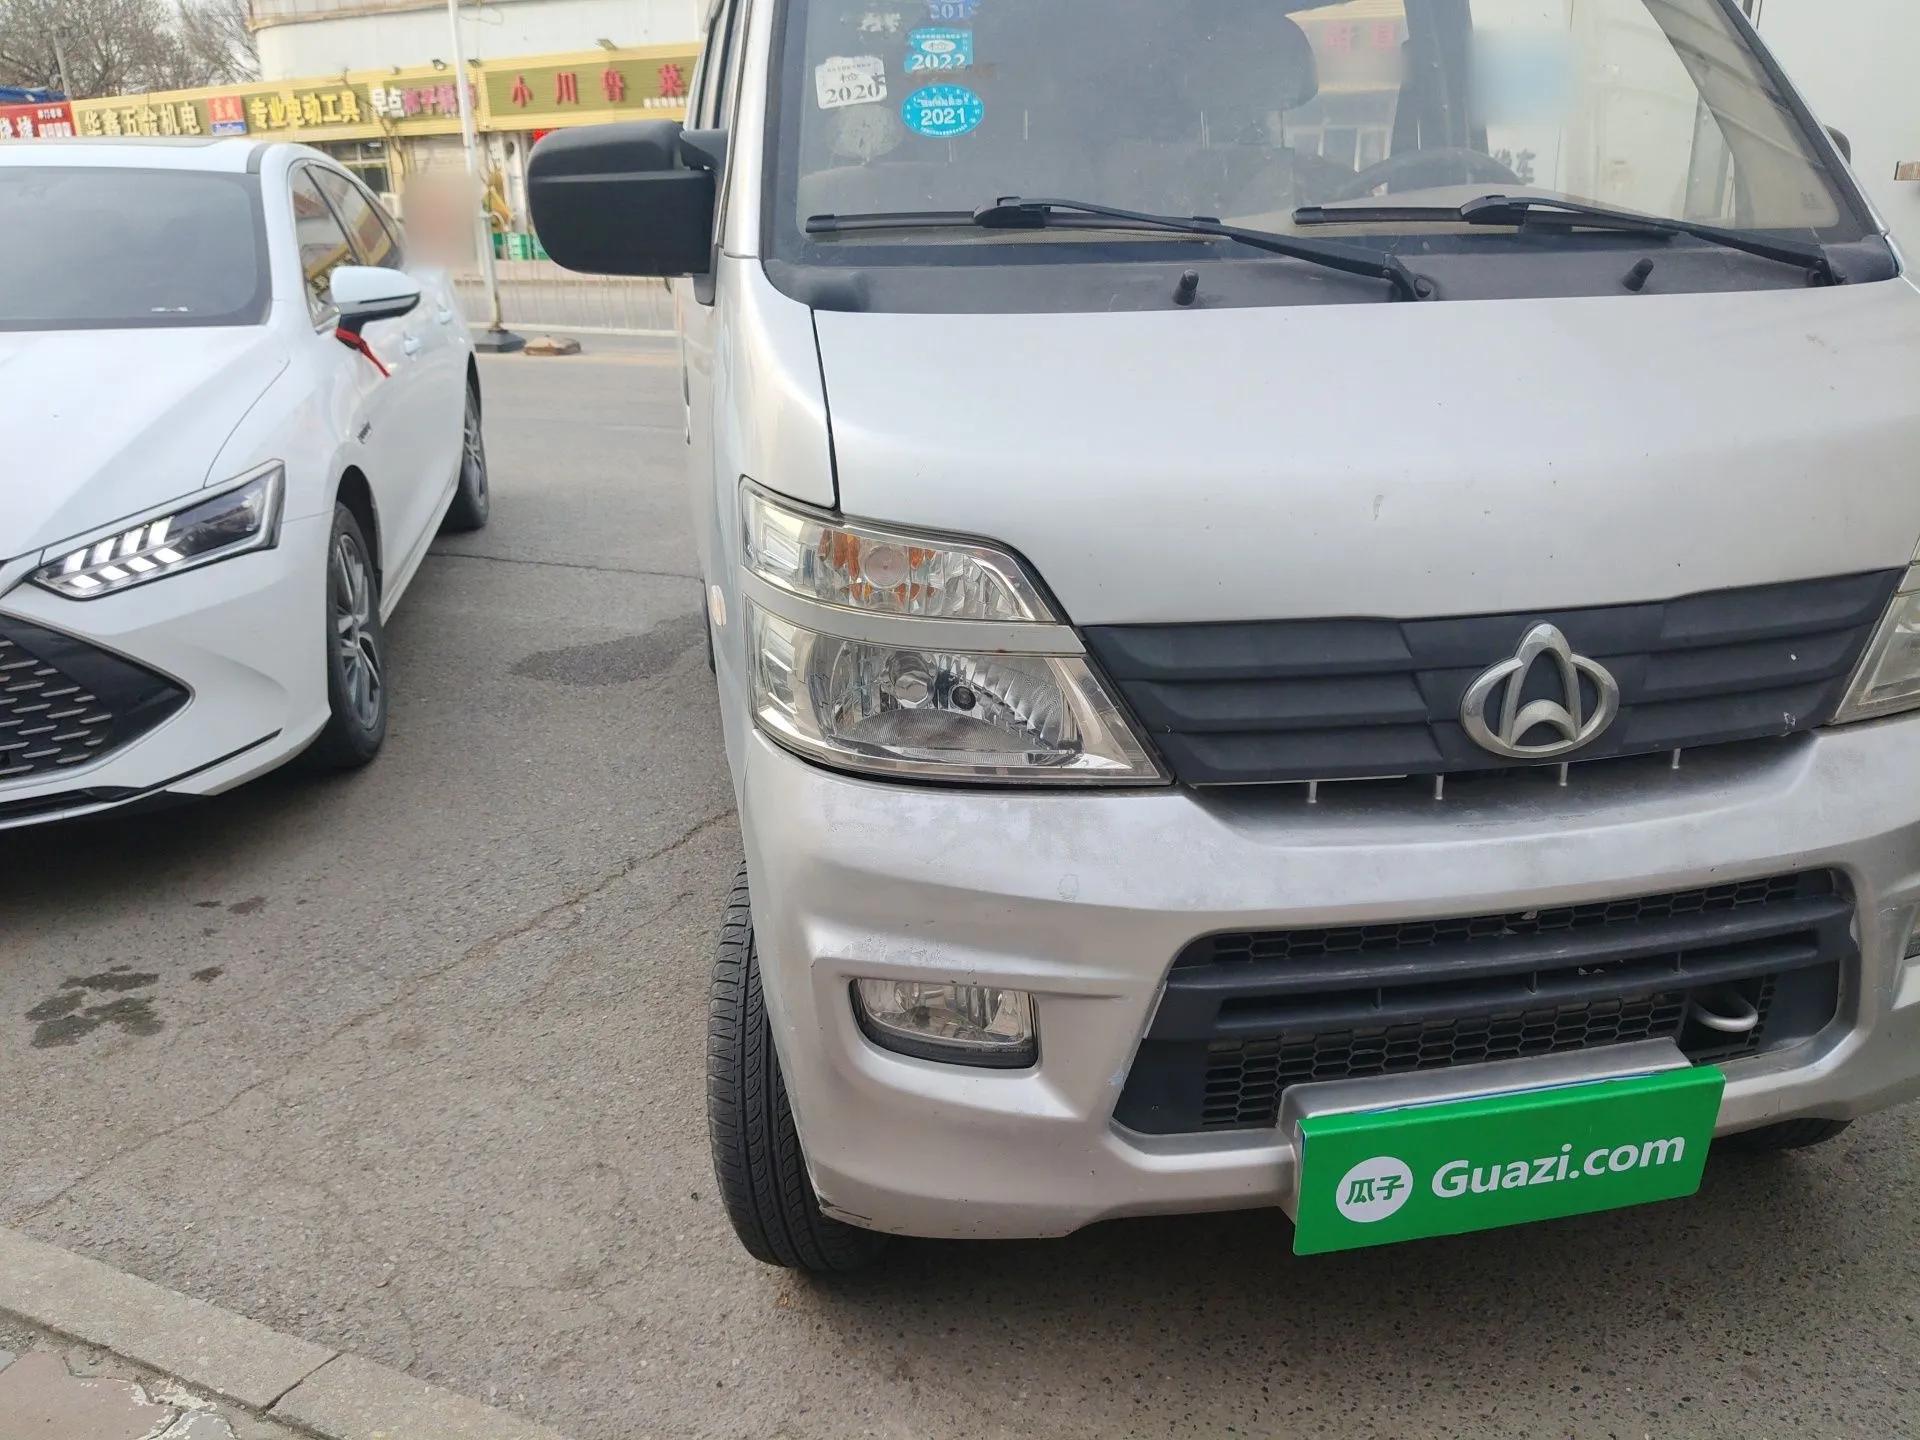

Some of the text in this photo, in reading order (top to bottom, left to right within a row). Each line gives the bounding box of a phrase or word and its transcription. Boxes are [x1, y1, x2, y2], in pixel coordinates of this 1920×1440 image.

[929, 3, 970, 20] 201
[911, 54, 966, 71] 2022
[825, 82, 881, 104] 2020
[250, 90, 361, 129] 专业电动工具
[920, 108, 966, 126] 2021
[1431, 1136, 1686, 1199] Guazi.com
[1345, 1173, 1405, 1206] 瓜子
